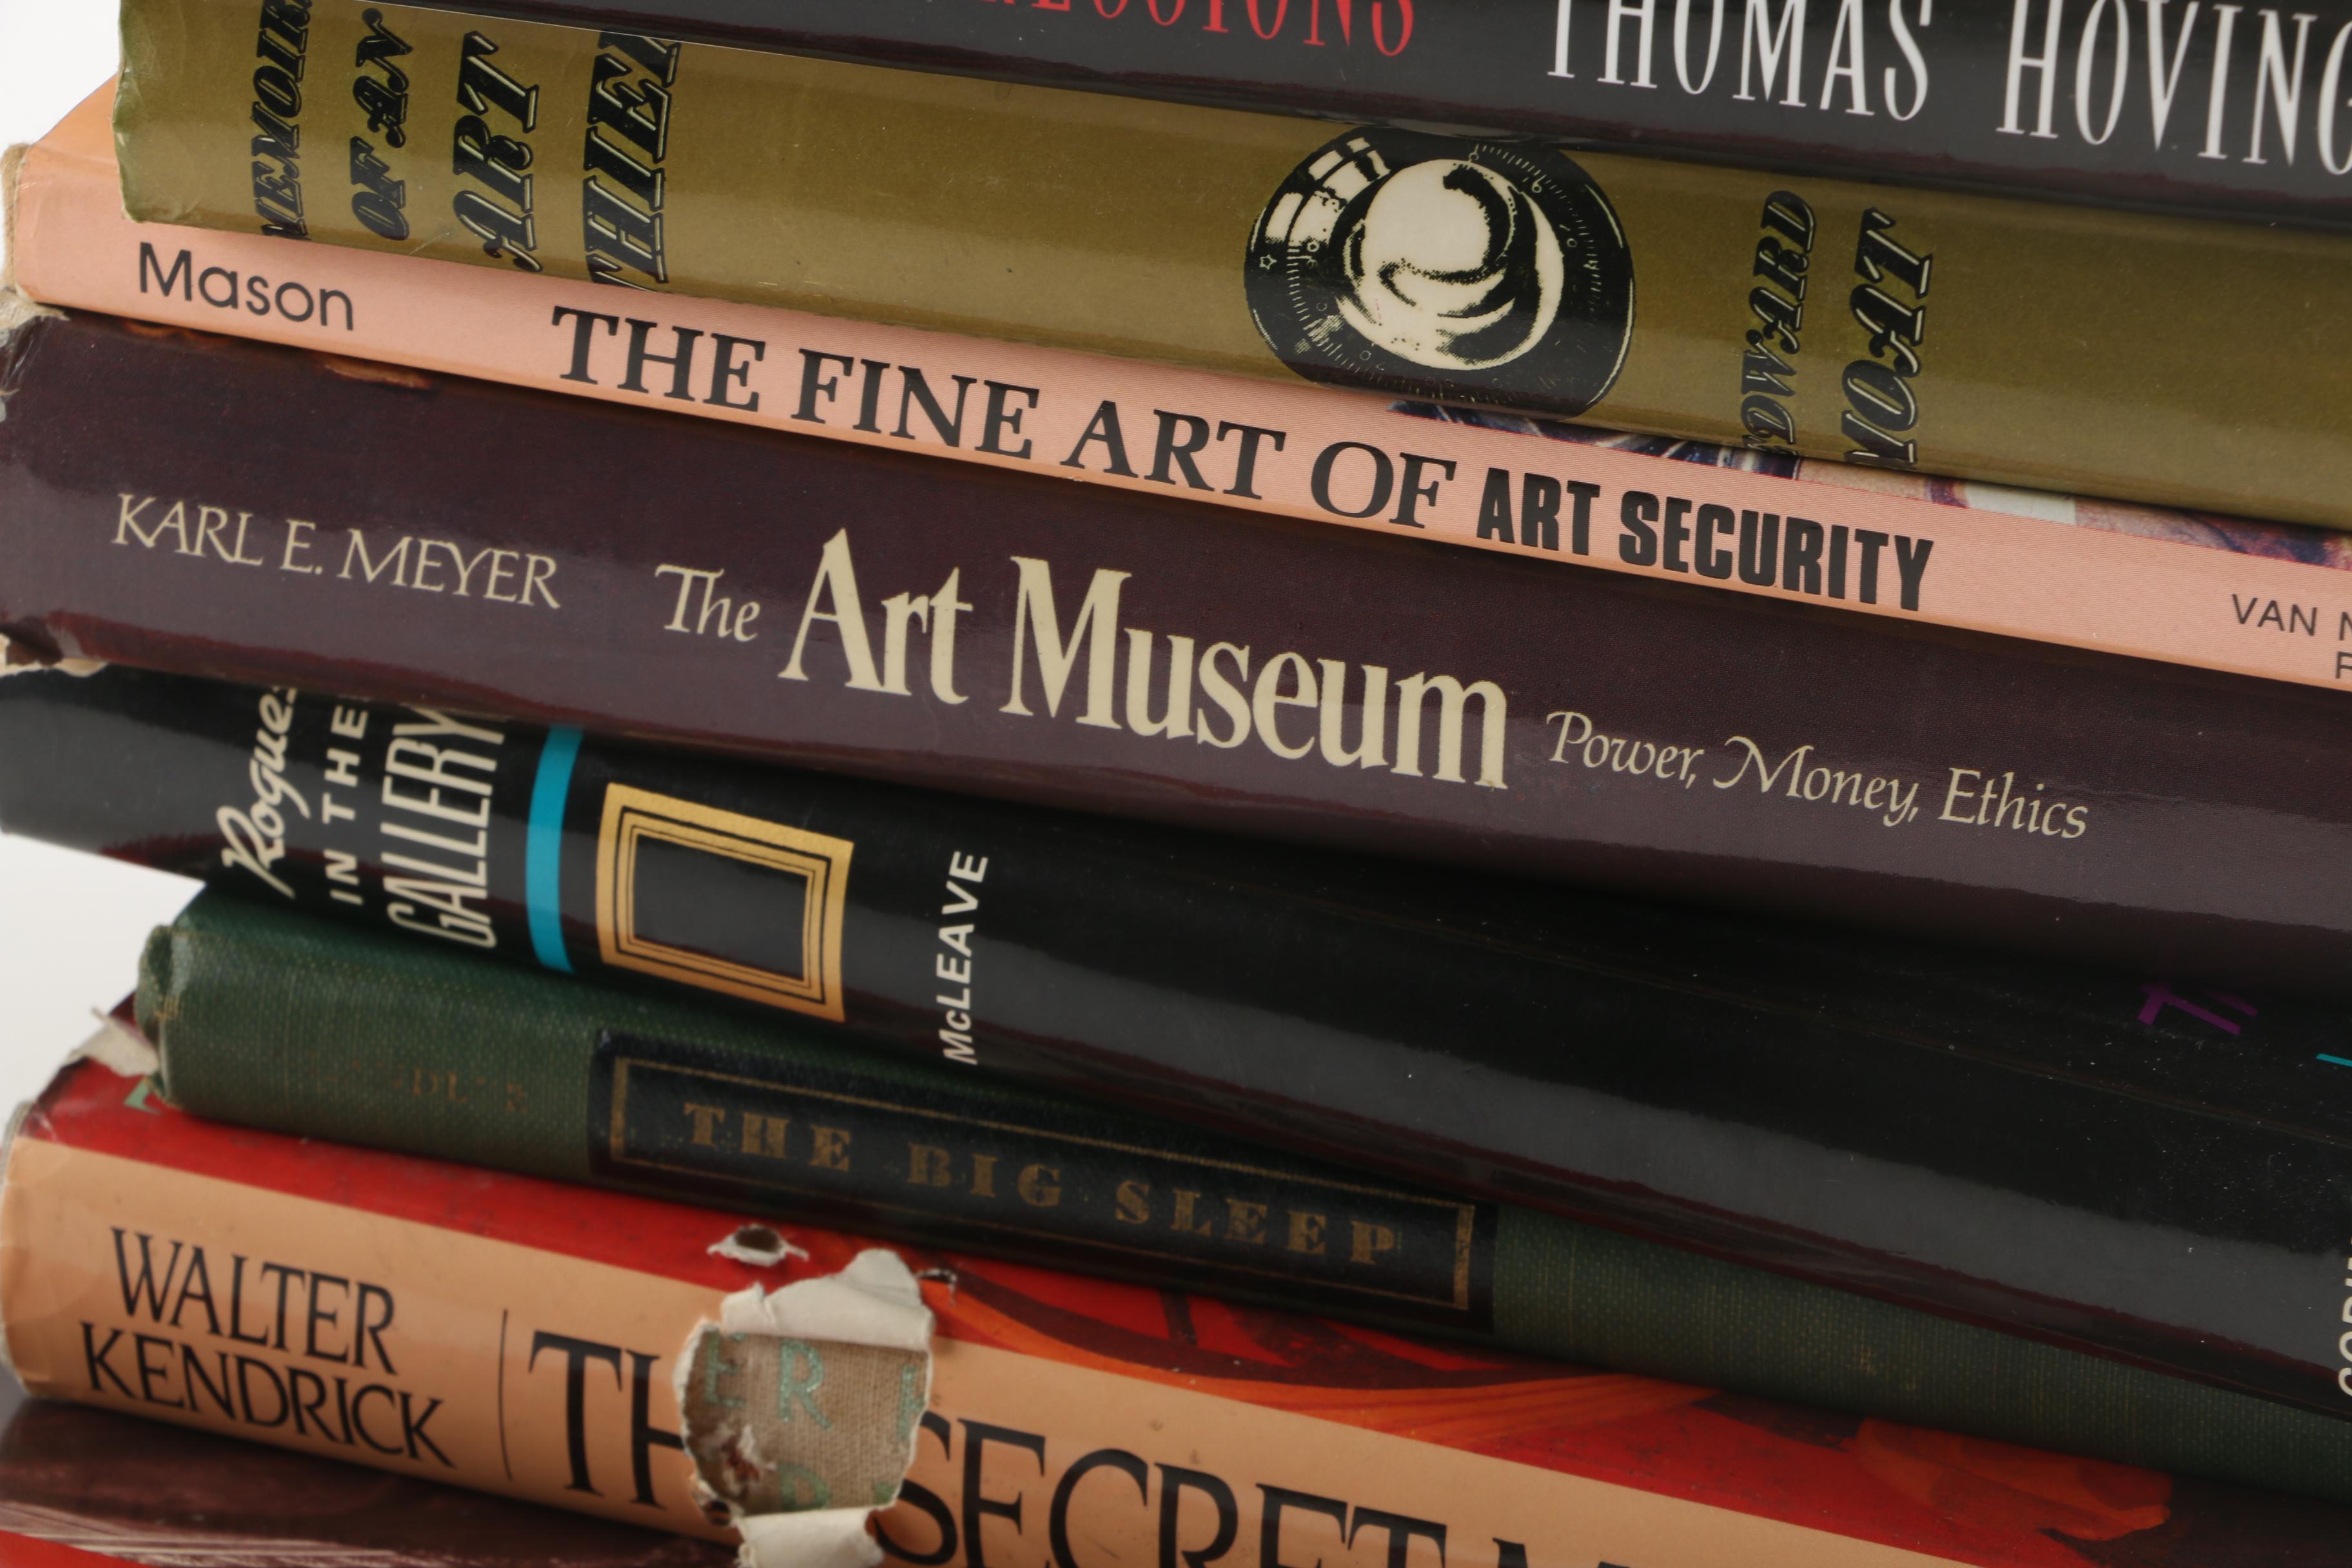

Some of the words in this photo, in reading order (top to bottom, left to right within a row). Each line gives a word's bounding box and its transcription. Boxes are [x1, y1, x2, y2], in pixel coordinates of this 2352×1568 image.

[353, 8, 413, 148] AN
[350, 136, 409, 240] OF
[453, 31, 543, 271] ART
[139, 242, 353, 331] Mason
[553, 306, 766, 412] THE
[790, 348, 1039, 459] FINE
[1060, 400, 1287, 500] ART
[1310, 441, 1457, 529] OF
[1476, 468, 1600, 556] ART
[1619, 491, 1934, 611] SECURITY
[111, 493, 263, 566] KARL
[279, 520, 322, 575] E.
[337, 529, 561, 609] MEYER
[2231, 593, 2318, 636] VAN
[655, 563, 759, 642] The
[778, 527, 973, 705] Art
[999, 556, 1509, 790] Museum
[322, 705, 368, 823] THE
[380, 707, 505, 948] GALLERY
[1547, 711, 1704, 789] Power,
[1714, 736, 1919, 826] Money,
[1939, 767, 2089, 839] Ethics
[323, 848, 363, 904] IN
[936, 851, 988, 1065] McLEAVE
[684, 1102, 851, 1171] THE
[908, 1142, 1061, 1206] BIG
[1115, 1179, 1395, 1264] SLEEP
[111, 1228, 398, 1375] WALTER
[81, 1321, 455, 1468] KENDRICK
